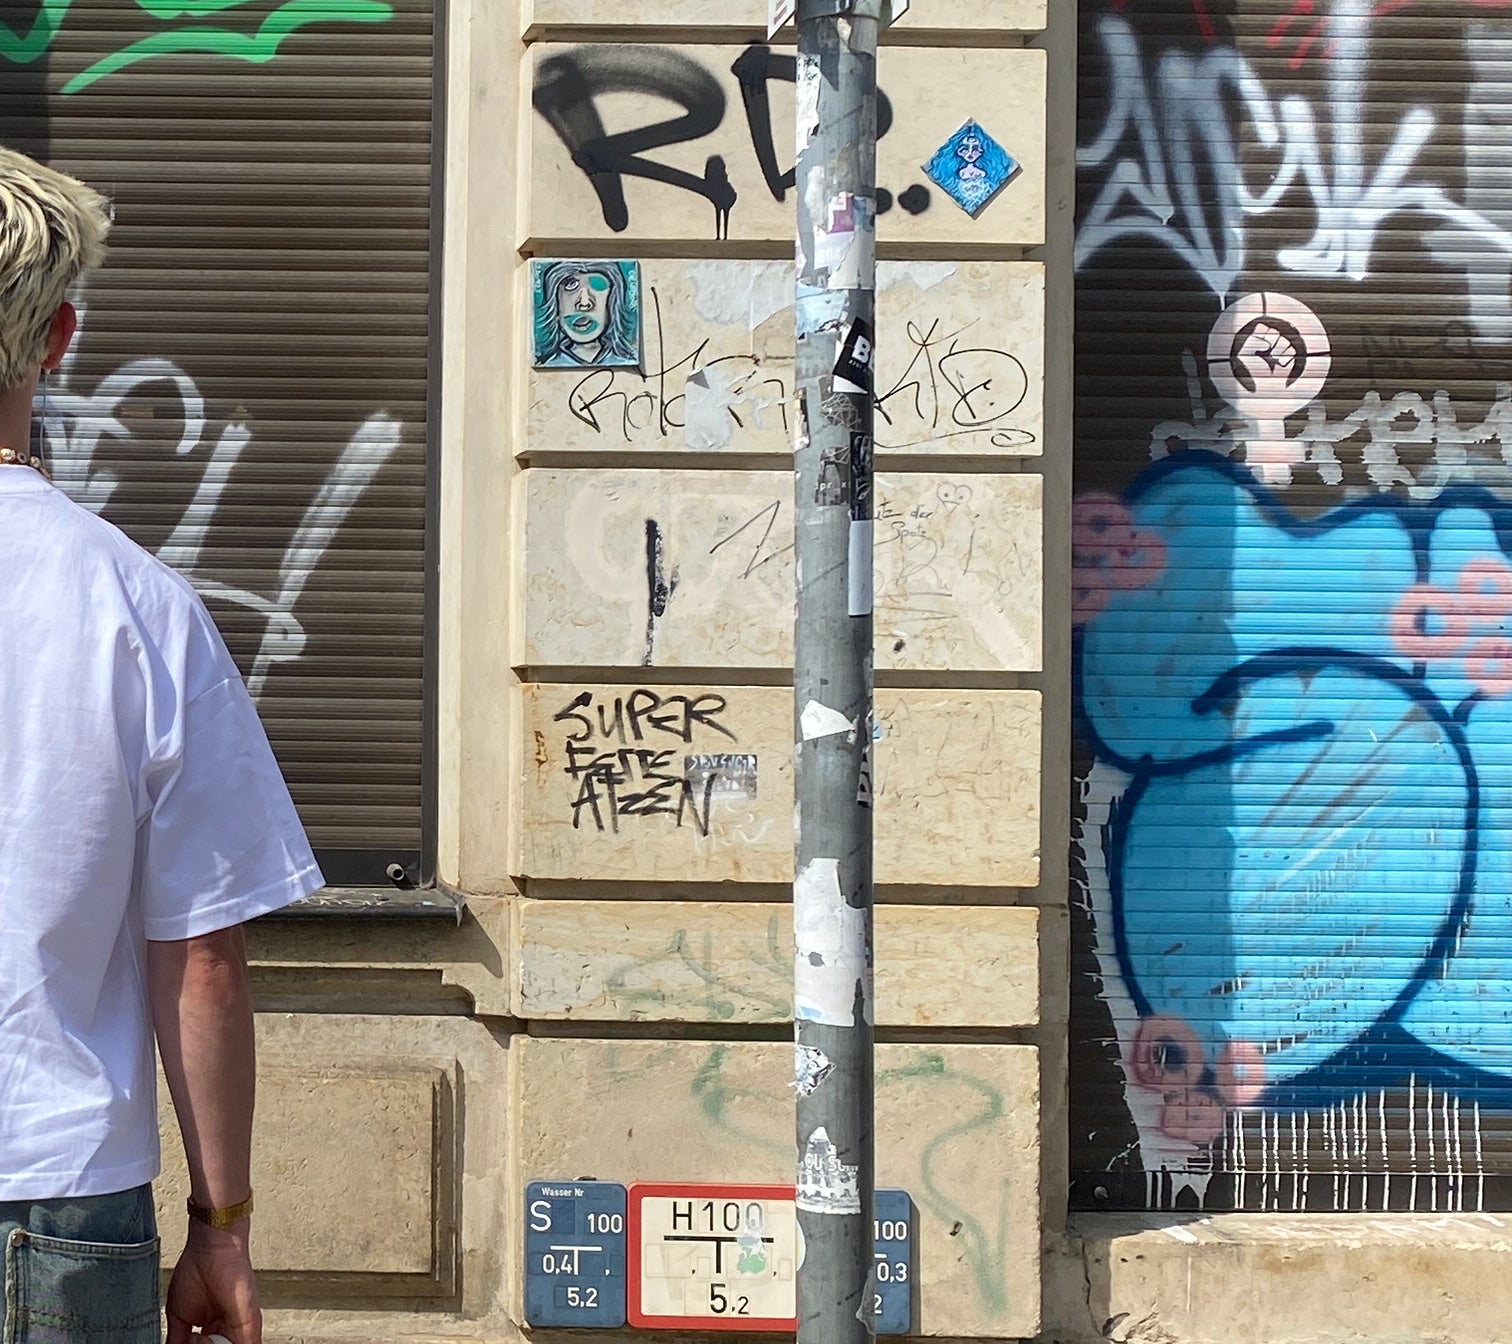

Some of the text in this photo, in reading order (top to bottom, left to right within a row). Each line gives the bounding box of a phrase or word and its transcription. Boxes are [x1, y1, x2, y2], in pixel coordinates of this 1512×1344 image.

[553, 689, 738, 745] SUPER
[541, 1187, 585, 1197] Wasser Nr
[530, 1200, 623, 1234] S 100
[542, 1253, 573, 1275] 0,4
[876, 1261, 908, 1283] 0,3
[567, 1286, 598, 1308] 5,2
[709, 1282, 751, 1315] 5,2
